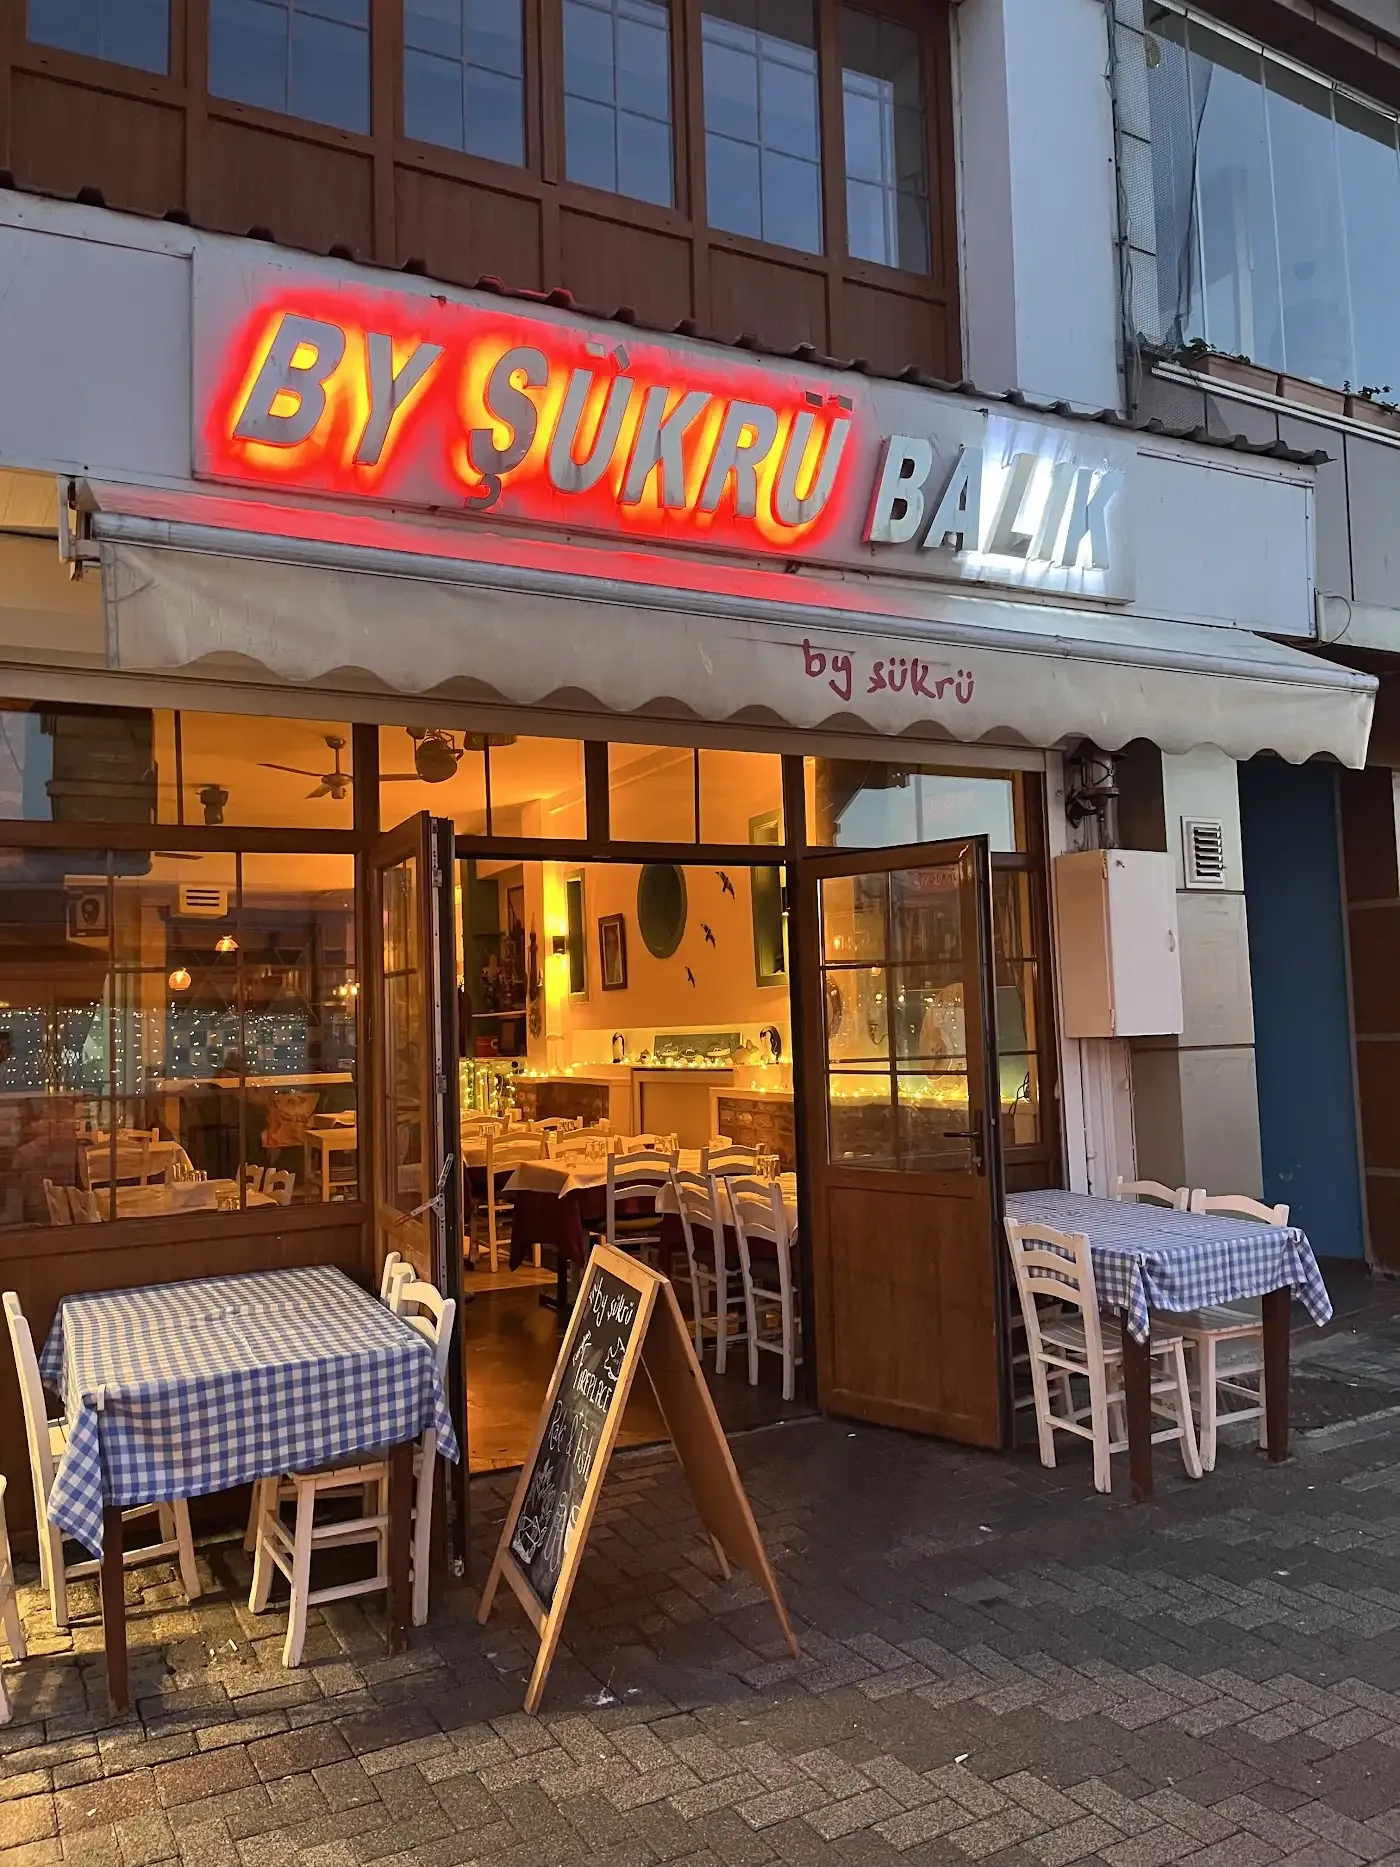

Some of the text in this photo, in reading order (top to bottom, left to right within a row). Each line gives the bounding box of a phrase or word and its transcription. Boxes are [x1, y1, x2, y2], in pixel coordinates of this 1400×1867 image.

[232, 313, 1126, 571] BY ŞÜKRÜ BALIK
[803, 638, 852, 702] by
[593, 1277, 608, 1327] by
